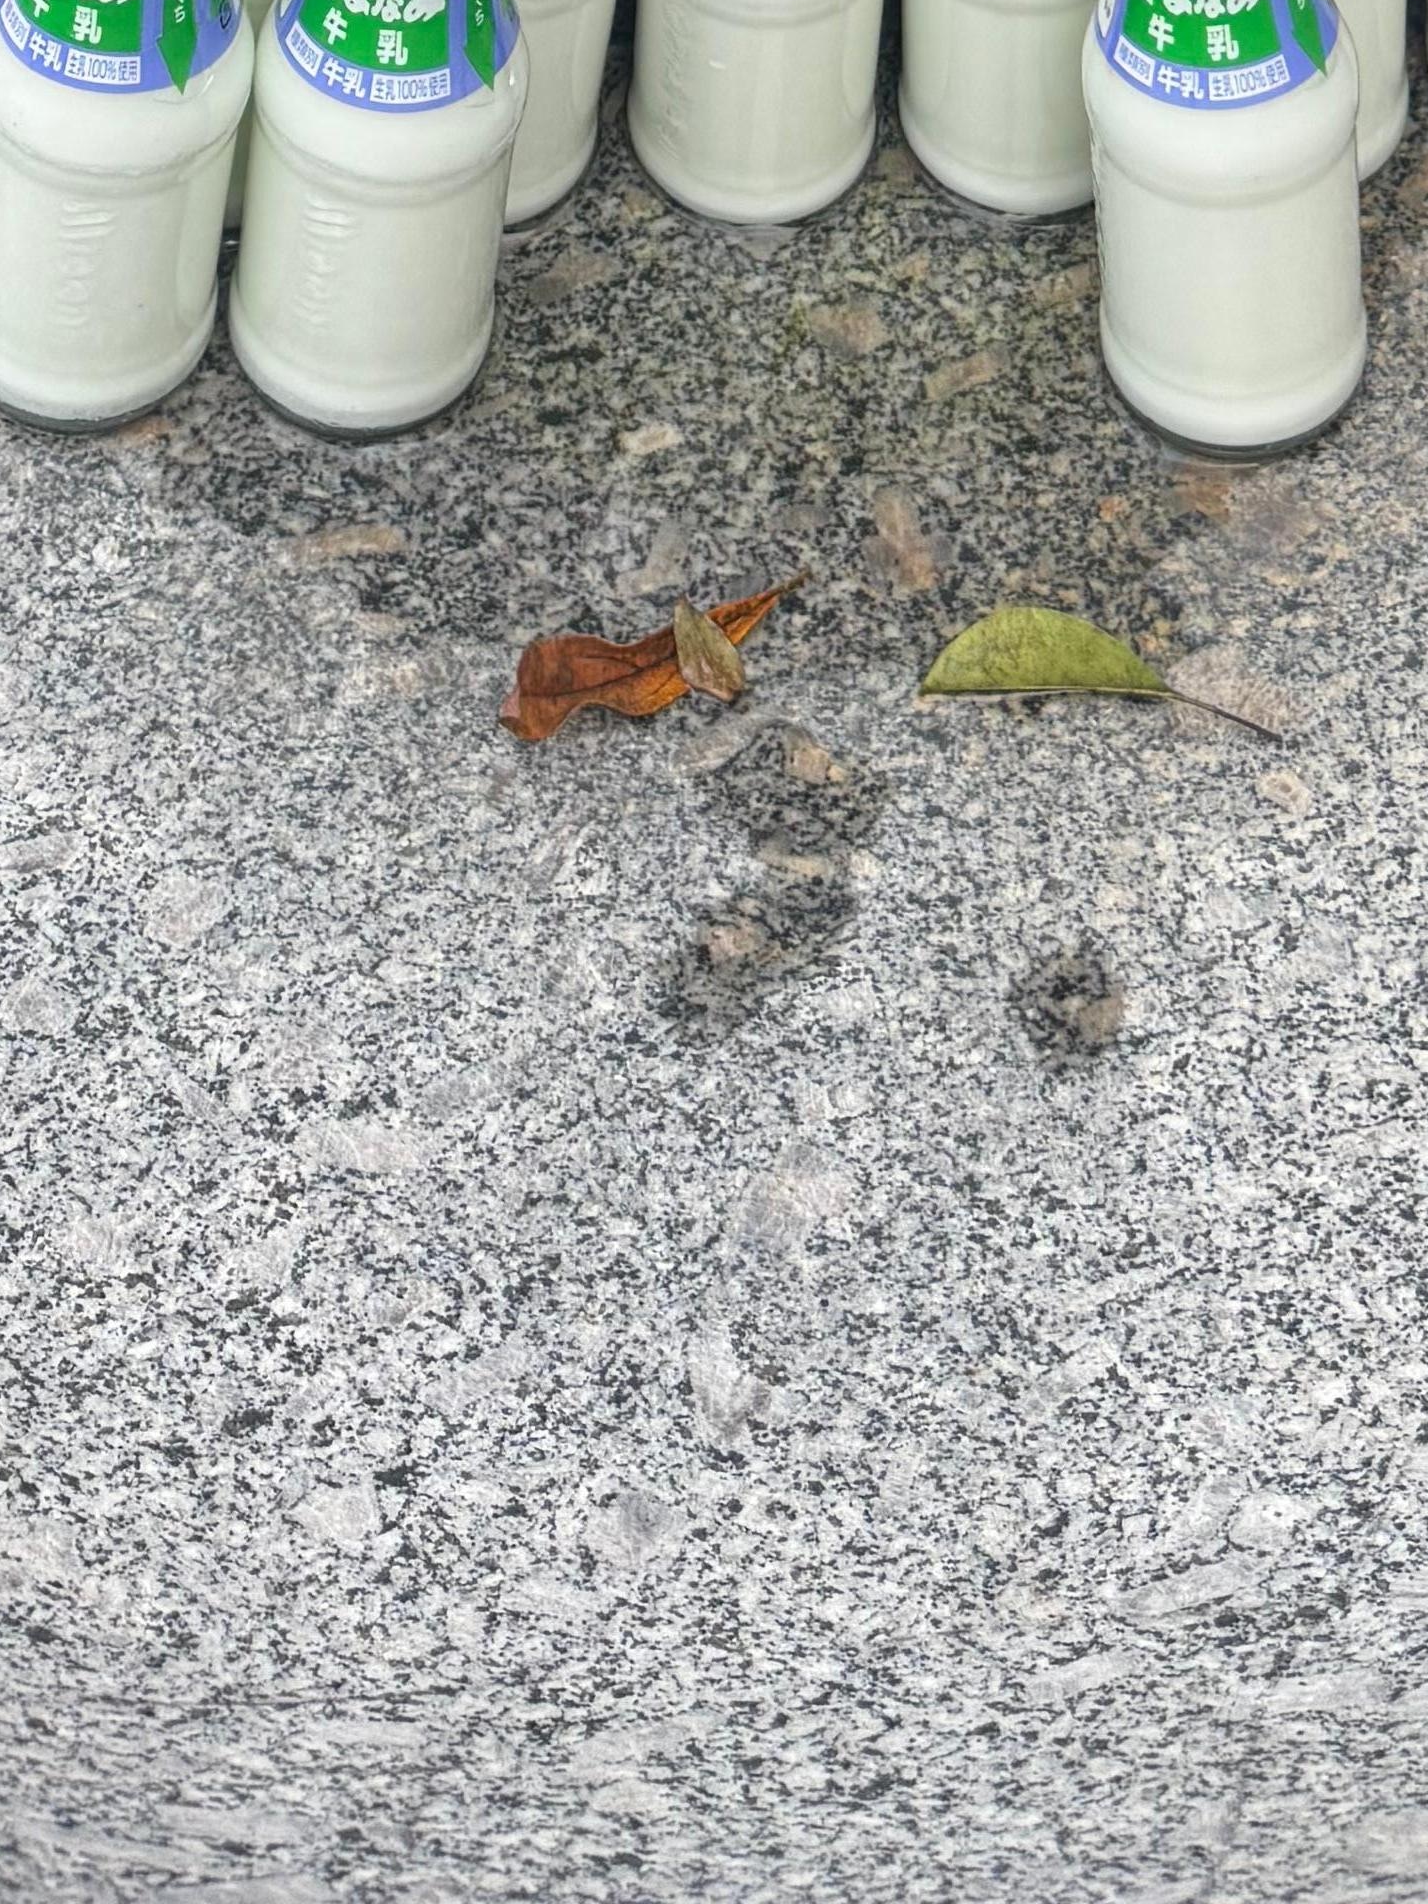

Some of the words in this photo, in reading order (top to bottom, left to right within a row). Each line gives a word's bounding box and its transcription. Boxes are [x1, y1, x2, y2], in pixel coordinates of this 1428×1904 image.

[28, 30, 62, 72] 牛乳
[68, 52, 139, 83] 生乳100%使用
[321, 60, 366, 99] 牛乳
[373, 70, 449, 101] 生乳100%使用
[1157, 64, 1205, 100] 牛乳
[1210, 58, 1290, 101] 生乳100%使用
